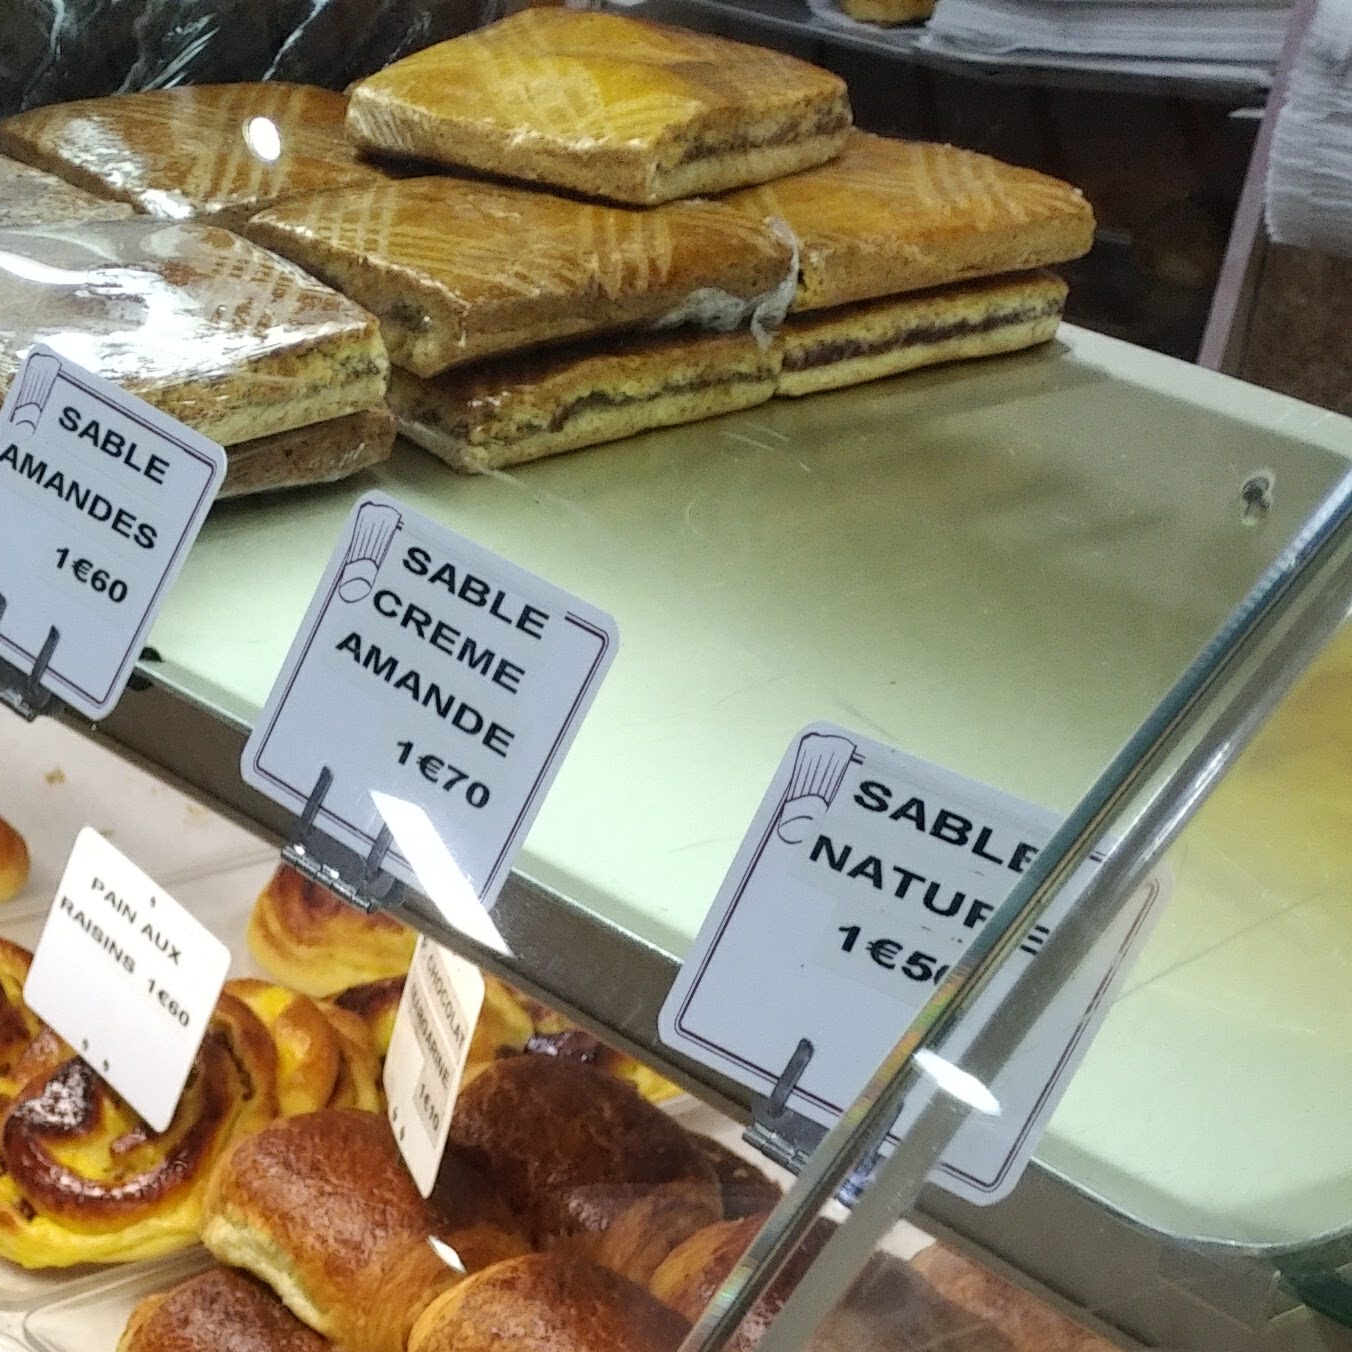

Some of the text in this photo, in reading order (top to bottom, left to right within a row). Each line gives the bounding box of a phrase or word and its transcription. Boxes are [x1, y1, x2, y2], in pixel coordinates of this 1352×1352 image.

[58, 405, 170, 485] SABLE
[55, 548, 129, 604] 1€60
[402, 546, 550, 640] SABLE
[373, 589, 526, 694] CREME
[335, 631, 516, 759] AMANDE
[396, 740, 491, 809] 1€70
[853, 780, 1040, 874] SABLE
[59, 896, 190, 1028] RAISINS 1€60
[90, 876, 182, 966] PAIN AUX
[838, 925, 950, 987] 1€5
[426, 953, 466, 1050] CHOCOLAT
